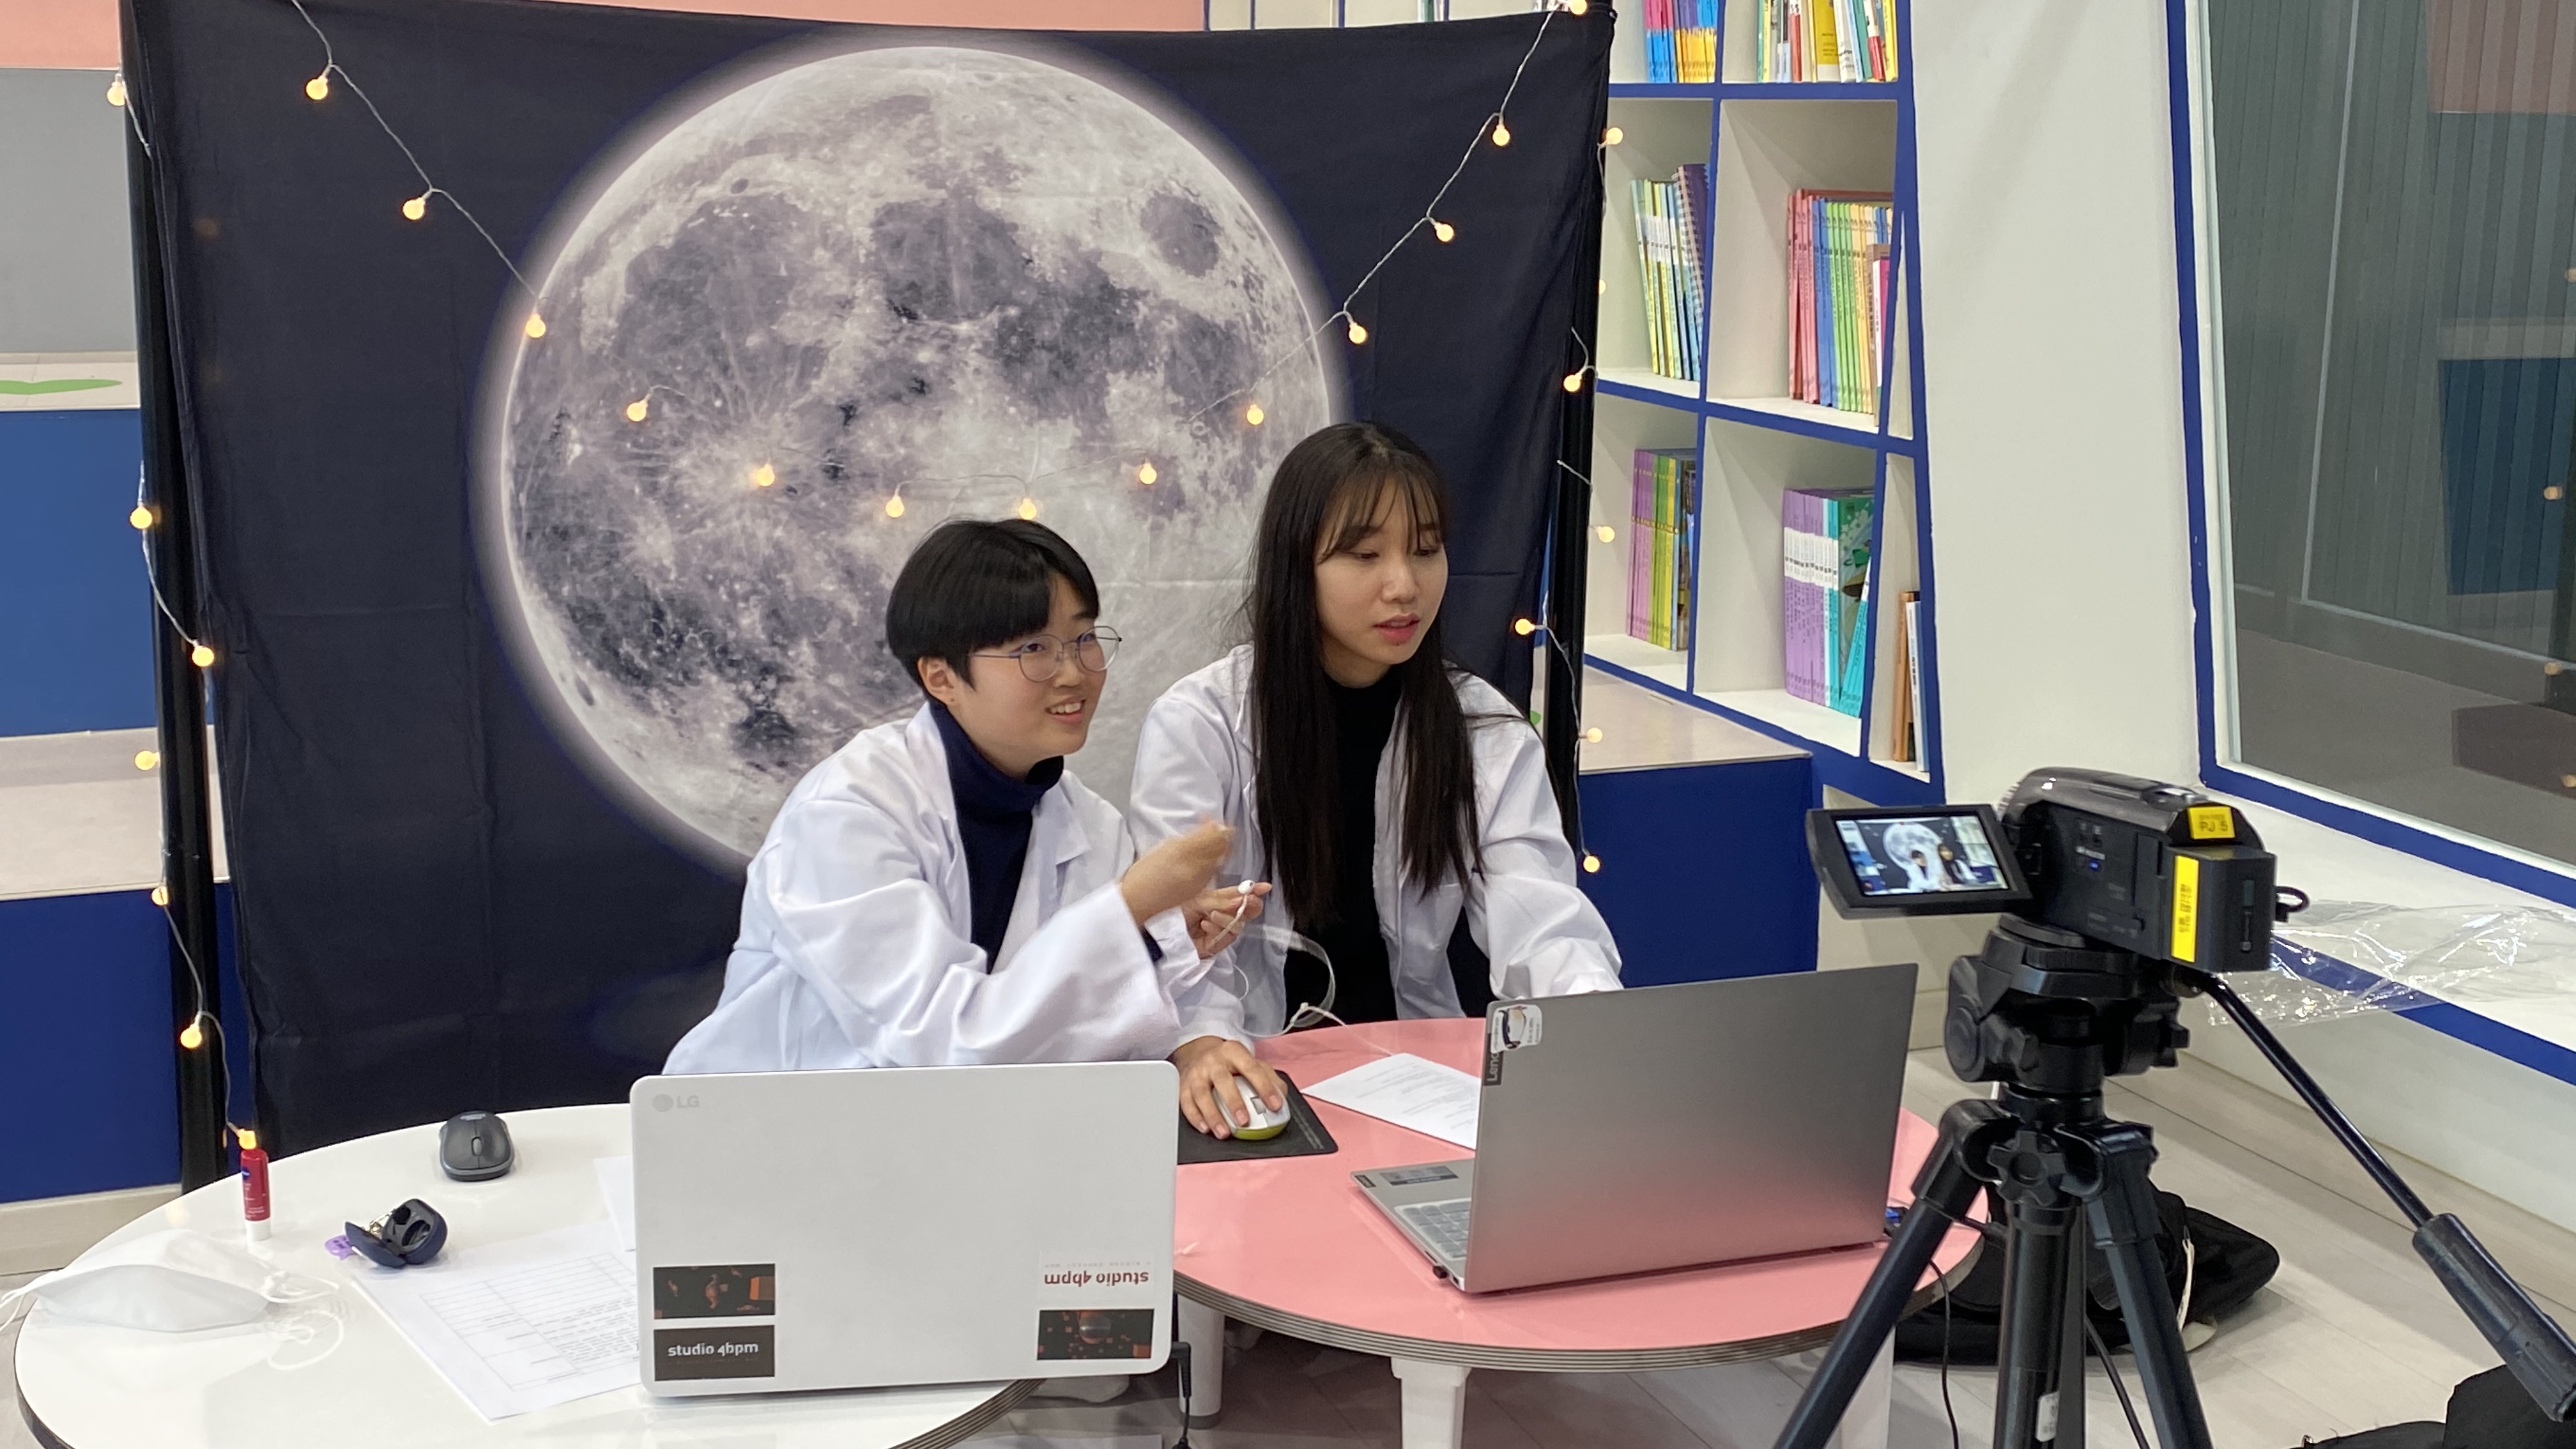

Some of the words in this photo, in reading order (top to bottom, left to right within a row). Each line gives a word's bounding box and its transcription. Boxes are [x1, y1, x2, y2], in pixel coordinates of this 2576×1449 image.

[677, 1094, 700, 1108] LG
[1044, 1271, 1092, 1287] 4bpm
[1096, 1271, 1149, 1287] studio
[668, 1343, 715, 1357] studio
[717, 1342, 759, 1357] 4bpm
